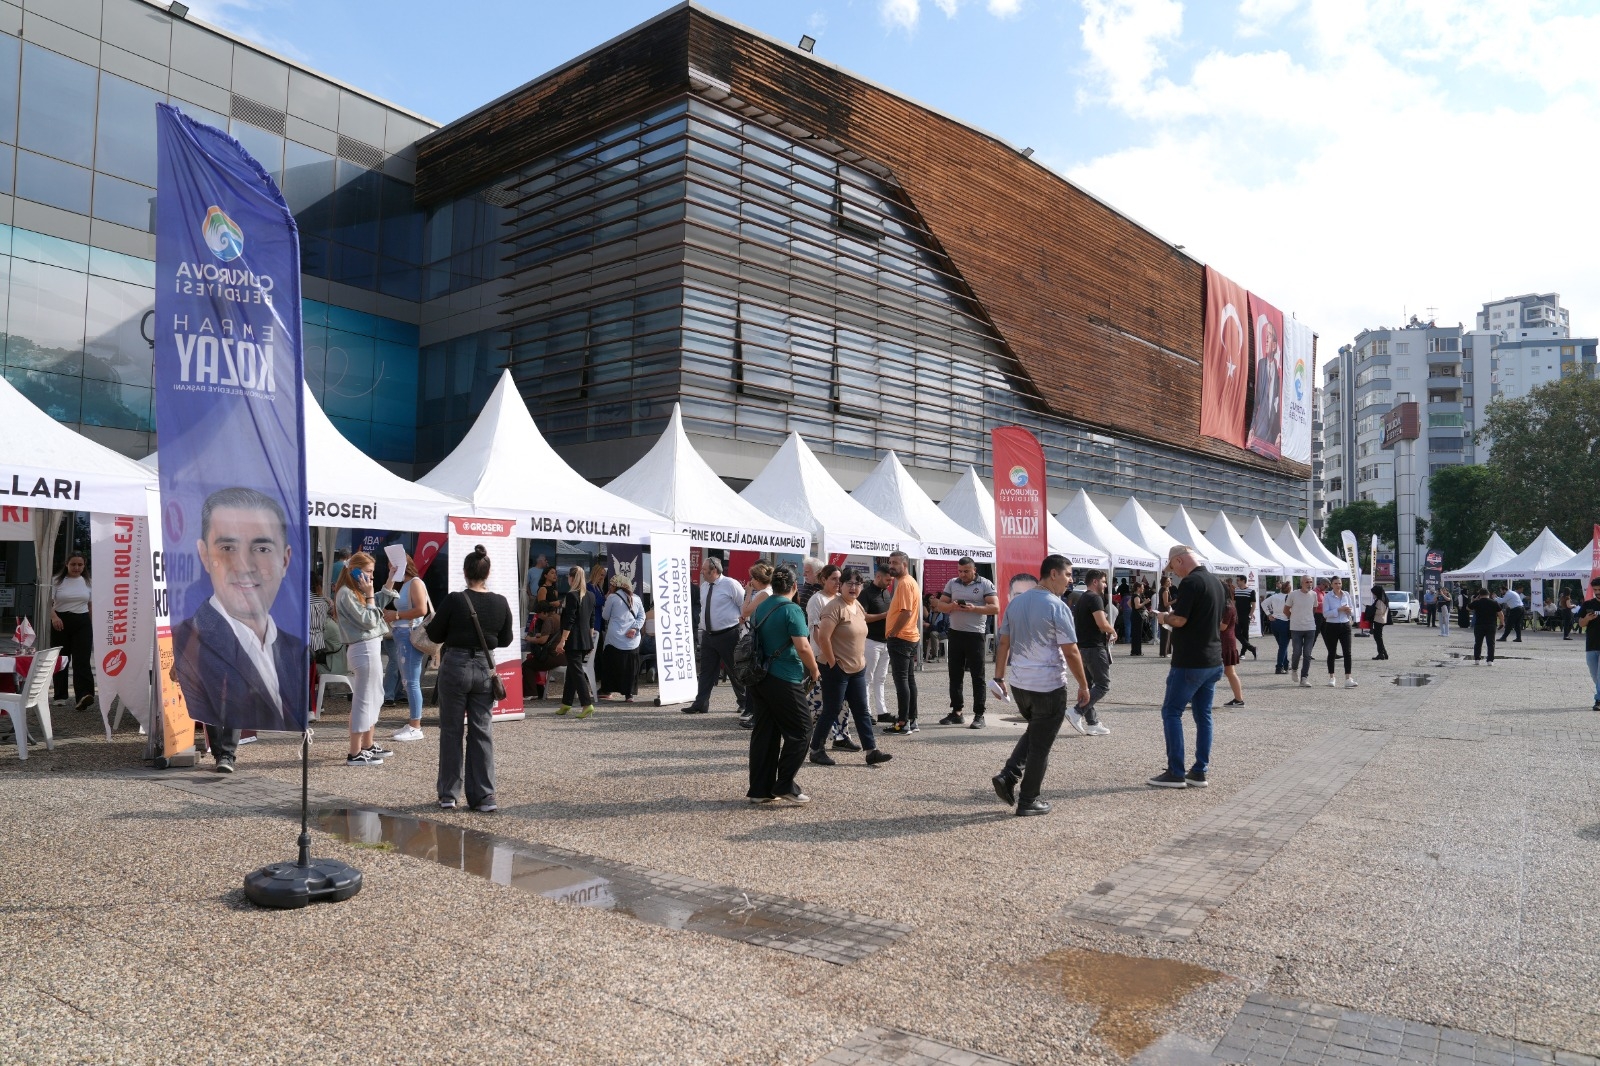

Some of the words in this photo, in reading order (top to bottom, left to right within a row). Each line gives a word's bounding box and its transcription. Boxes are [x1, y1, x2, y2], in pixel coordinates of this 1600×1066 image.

[307, 501, 377, 520] GROSERİ
[531, 516, 562, 533] MBA
[566, 519, 630, 537] OKULLARI
[114, 516, 135, 578] KOLEJİ
[710, 530, 740, 544] KOLEJİ
[741, 533, 769, 546] ADANA
[770, 535, 806, 549] KAMPÜSÜ
[850, 540, 880, 551] MEKTEBİM
[927, 546, 939, 555] ÖZEL
[671, 558, 682, 617] GRUBU
[106, 610, 114, 624] özel
[112, 583, 130, 646] ERKAN
[106, 625, 114, 646] adana
[658, 570, 675, 682] MEDICANA
[683, 605, 693, 679] EDUCATION
